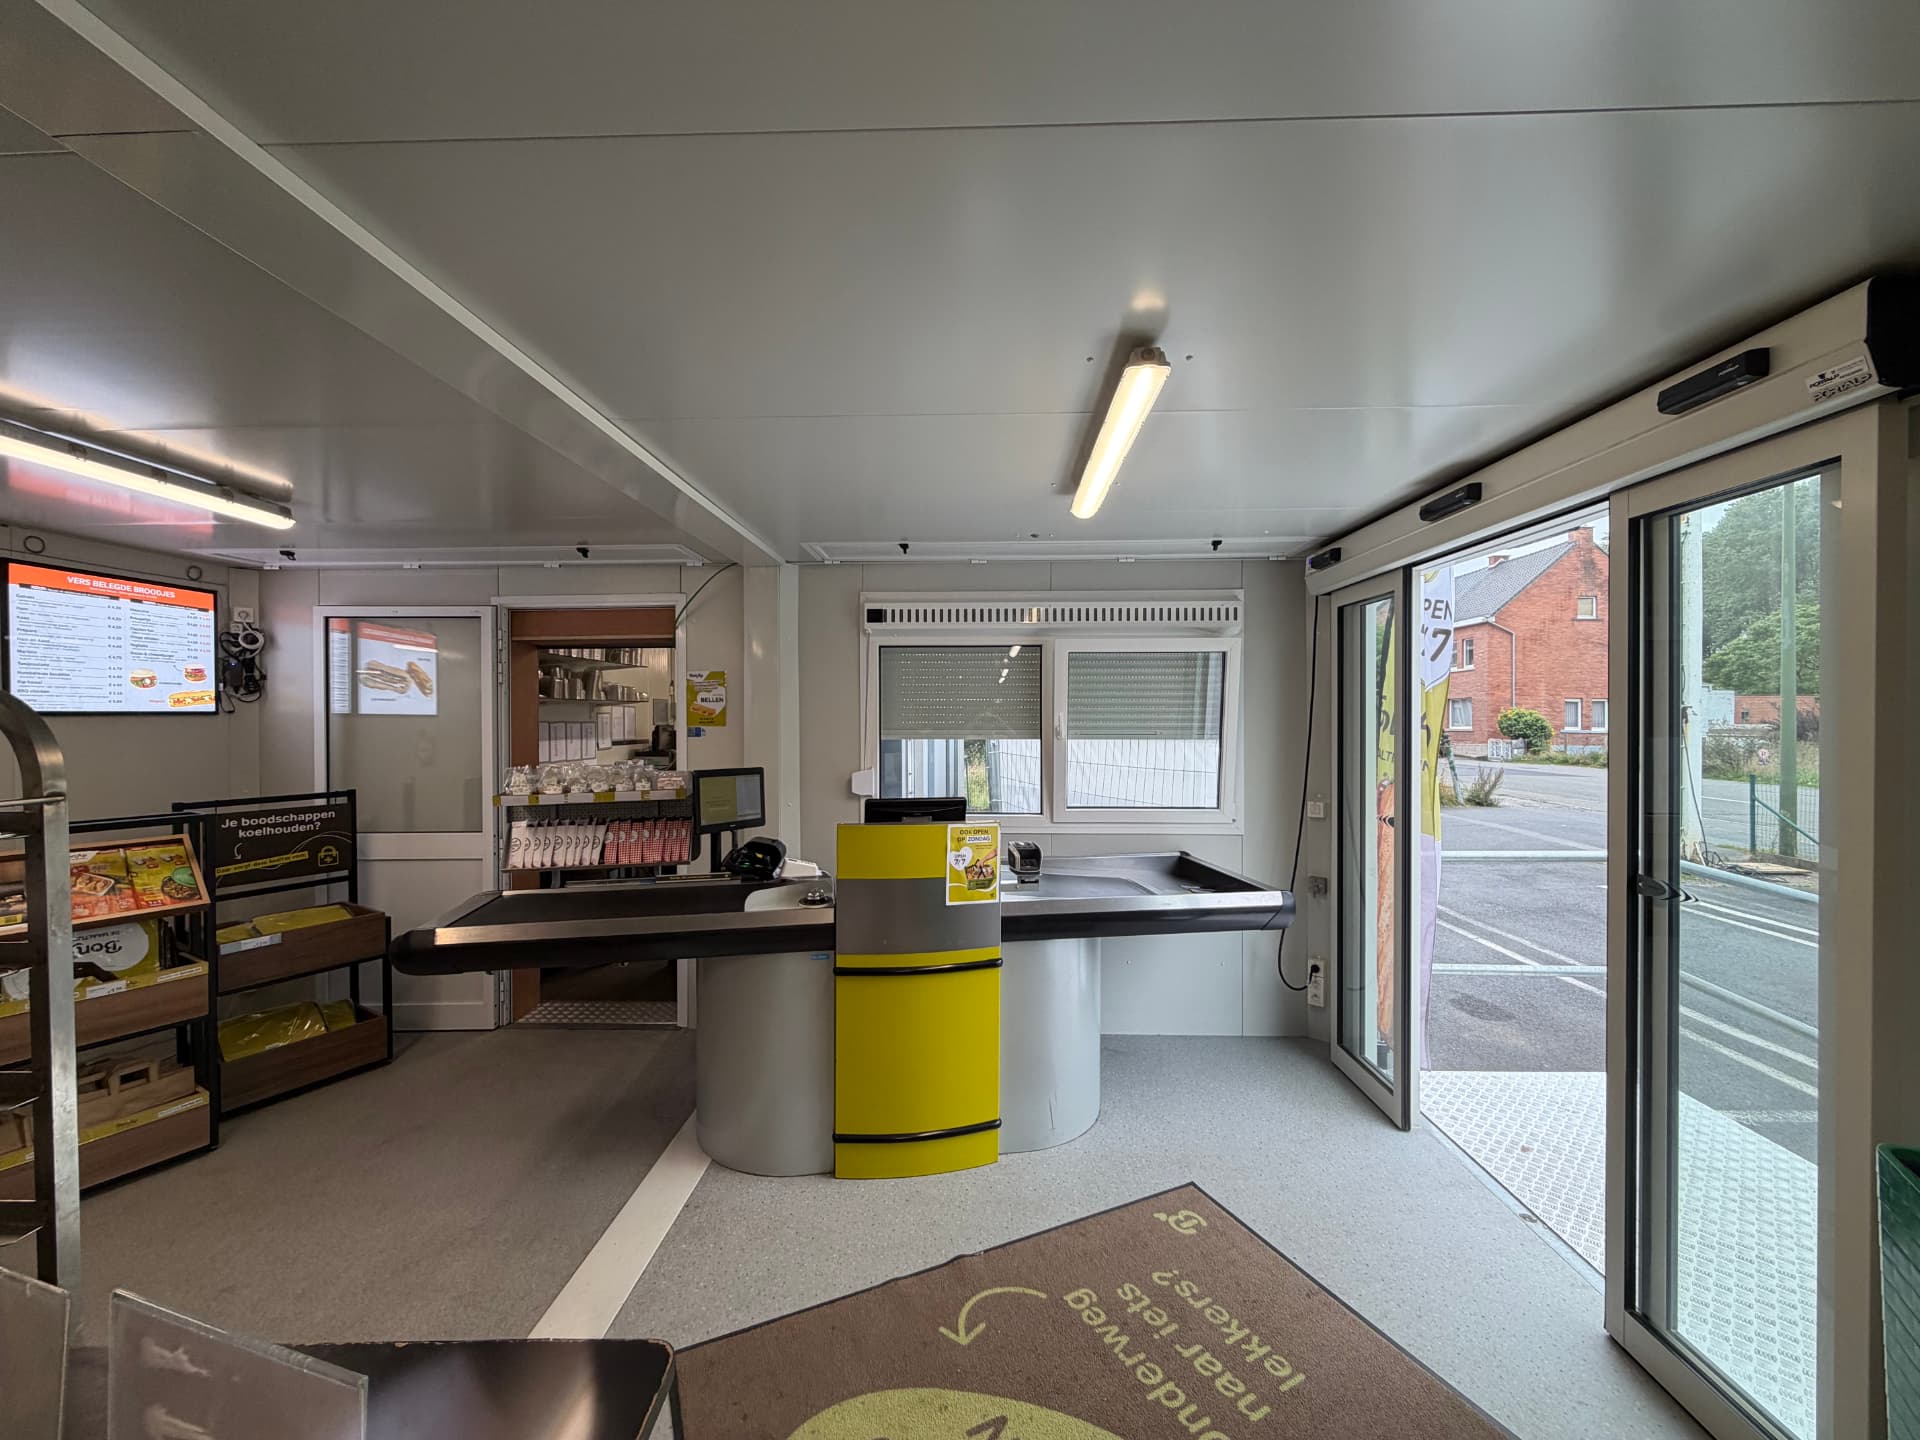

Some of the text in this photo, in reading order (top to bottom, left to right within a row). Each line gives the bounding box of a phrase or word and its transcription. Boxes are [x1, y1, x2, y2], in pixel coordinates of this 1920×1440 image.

[67, 576, 91, 586] VERS
[93, 580, 132, 592] BELEGDE
[134, 586, 176, 598] BROODJES
[1424, 598, 1453, 621] PEN
[221, 811, 336, 828] Je boodschappen
[238, 821, 321, 838] koelhouden?
[1151, 1269, 1306, 1392] lekkers?
[1116, 1282, 1271, 1421] naar iets
